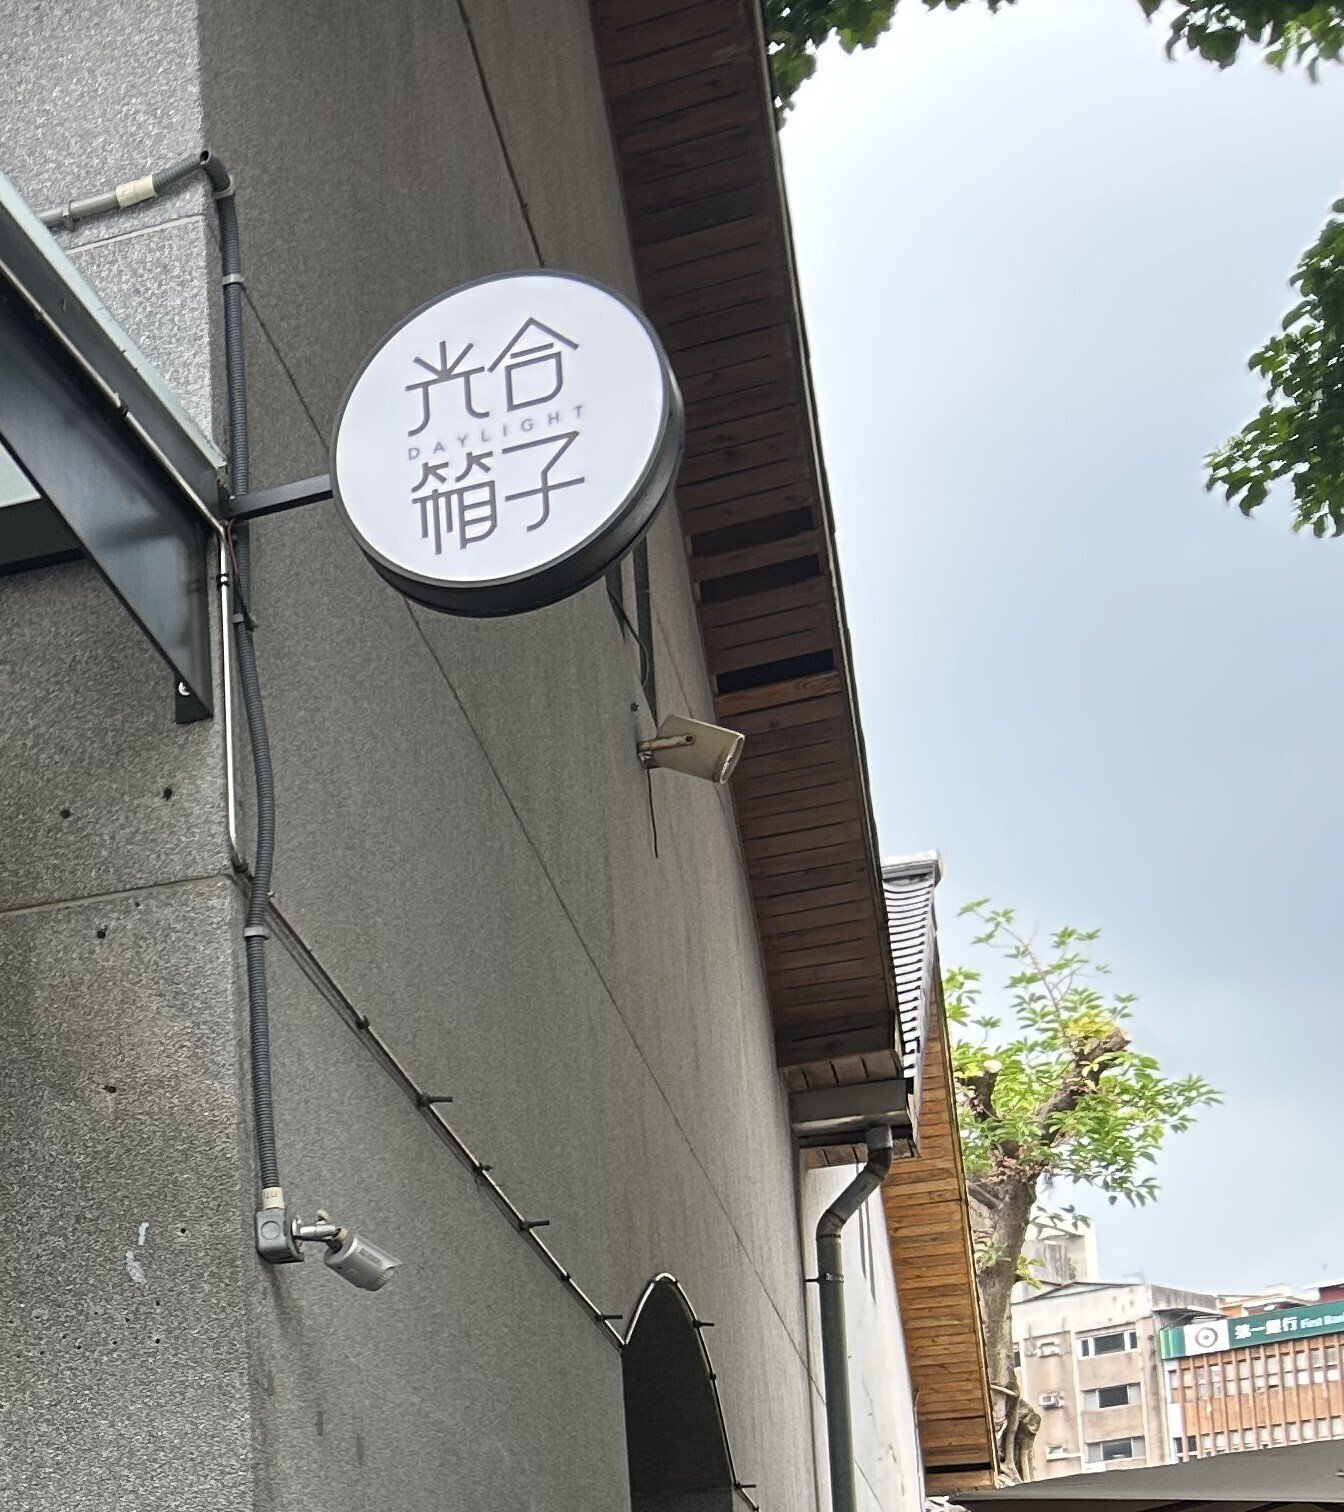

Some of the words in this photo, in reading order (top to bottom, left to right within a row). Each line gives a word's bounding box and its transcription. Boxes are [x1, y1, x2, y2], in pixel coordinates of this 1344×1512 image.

[405, 317, 580, 437] 光合
[408, 404, 587, 461] DAYLIGHT
[411, 430, 586, 555] 箱子
